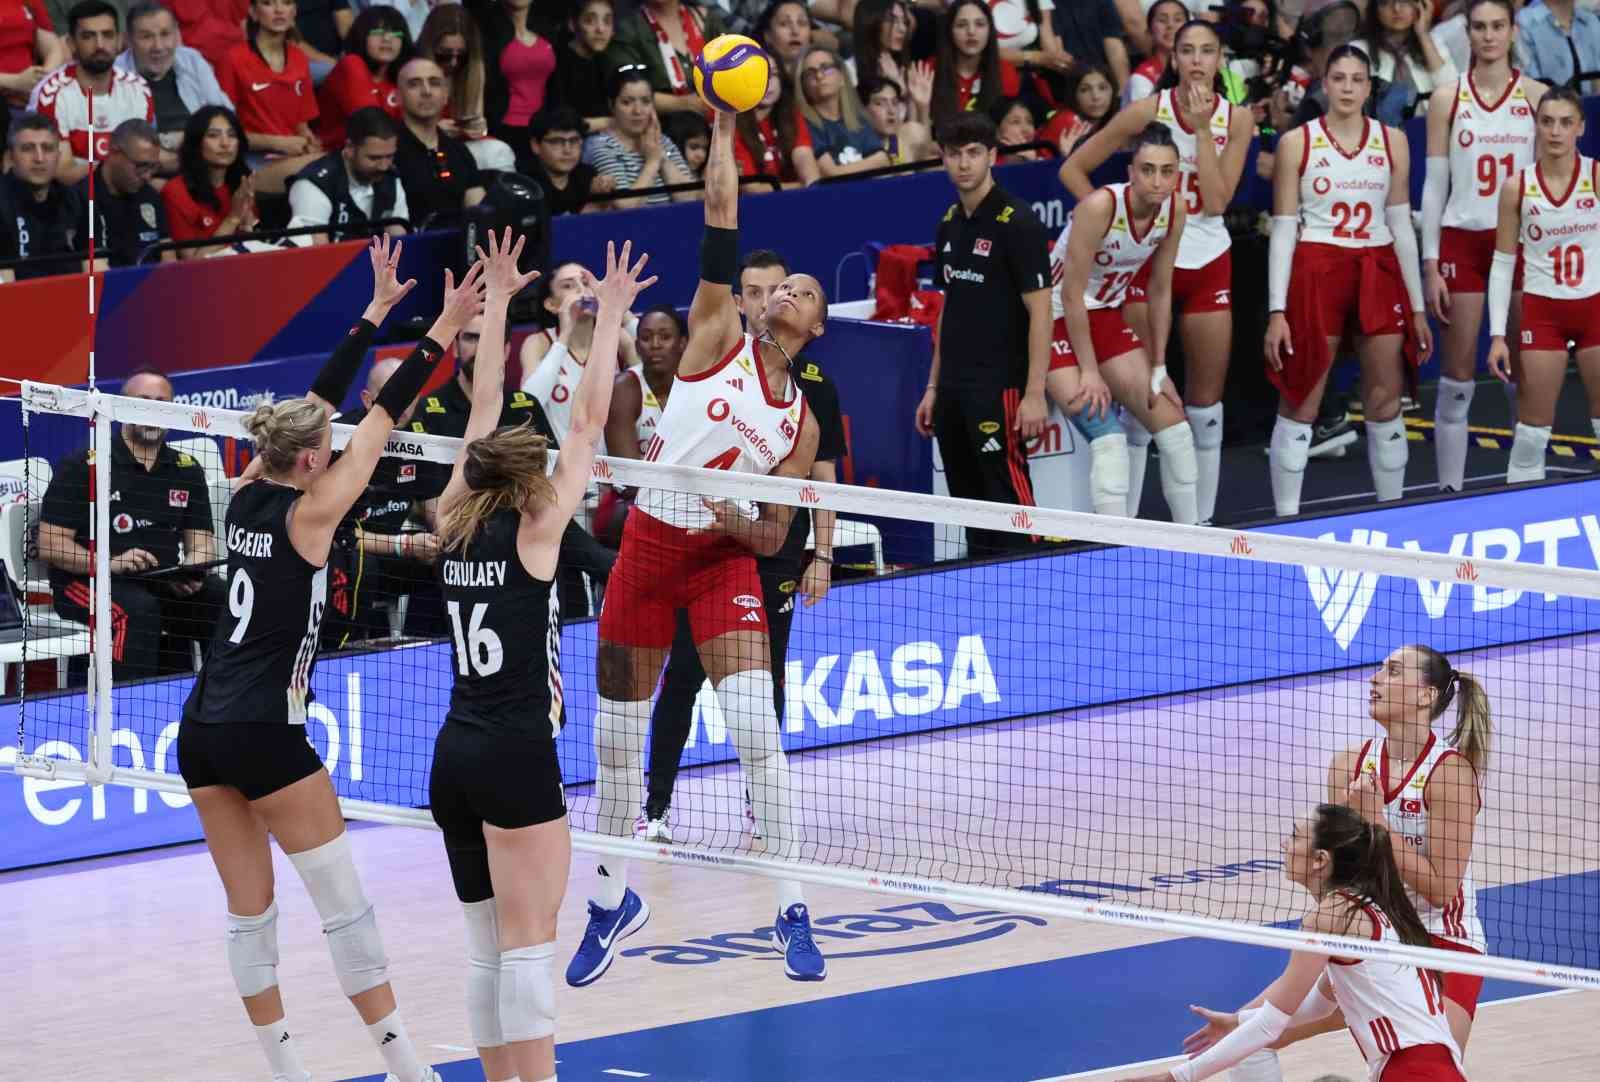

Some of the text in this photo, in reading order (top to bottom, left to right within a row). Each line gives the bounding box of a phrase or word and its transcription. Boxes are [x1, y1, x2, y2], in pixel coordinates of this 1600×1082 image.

[1478, 132, 1528, 145] vodafone
[1335, 179, 1385, 192] vodafone
[1477, 153, 1514, 197] 91
[1331, 201, 1372, 239] 22
[1545, 221, 1598, 237] vodafone
[1548, 244, 1584, 287] 10
[1052, 339, 1072, 355] 12
[730, 415, 778, 466] vodafone
[228, 567, 255, 645] 9
[447, 600, 504, 678] 16
[683, 634, 1001, 749] KASA
